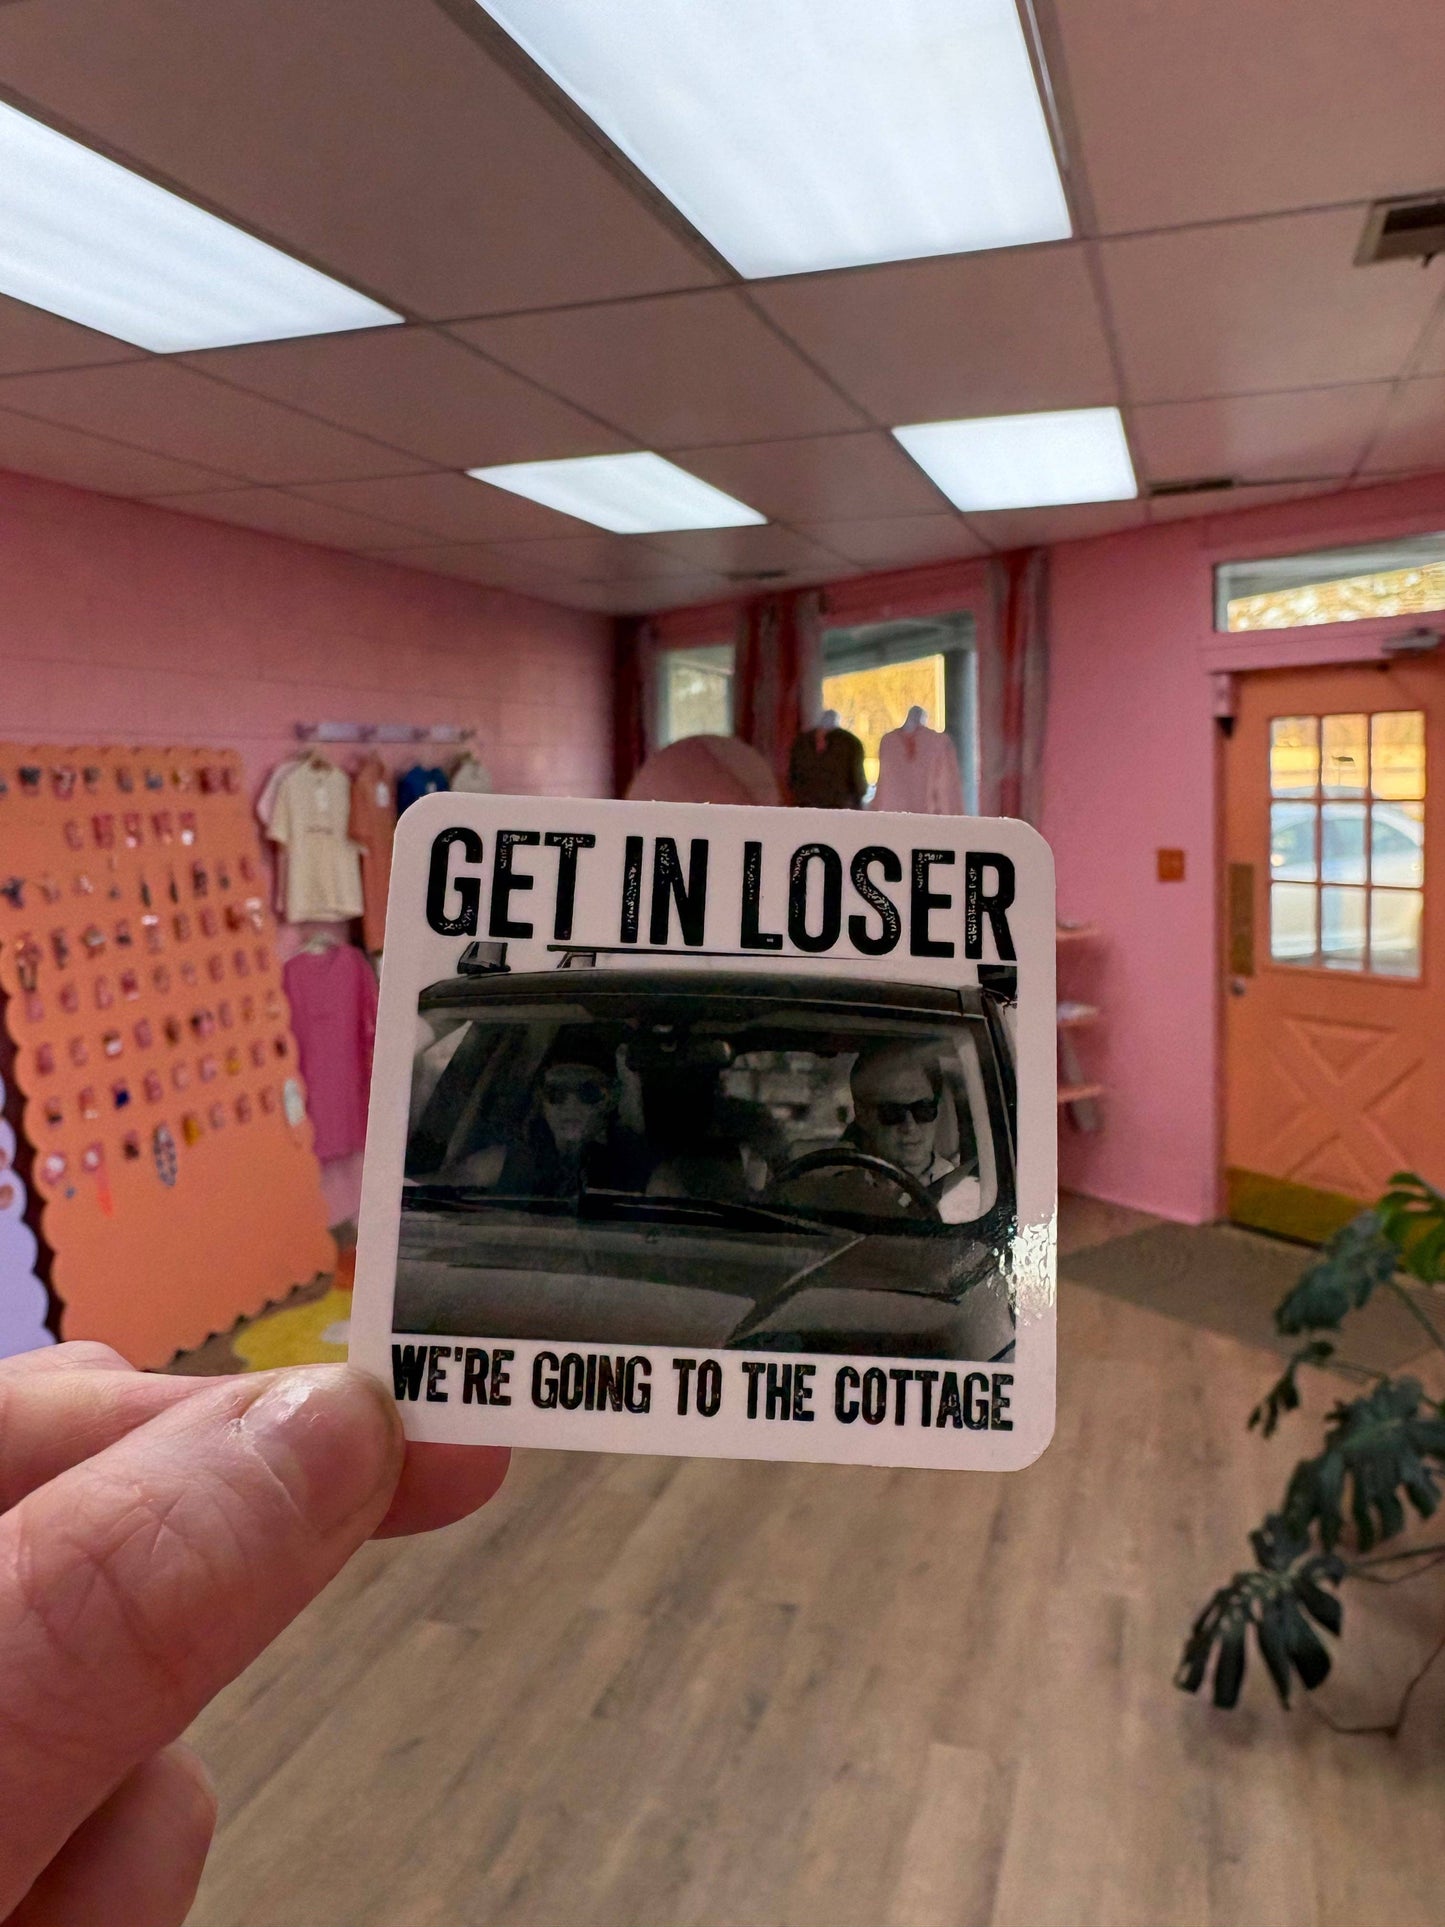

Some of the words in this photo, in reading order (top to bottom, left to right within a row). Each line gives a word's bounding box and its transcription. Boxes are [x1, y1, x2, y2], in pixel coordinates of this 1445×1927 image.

[426, 827, 596, 941] GET
[620, 836, 708, 946] IN
[740, 841, 1017, 961] LOSER
[391, 1344, 515, 1407] WE'RE
[531, 1351, 652, 1414] GOING
[673, 1358, 723, 1418] TO
[741, 1362, 817, 1422] THE
[834, 1366, 1014, 1432] COTTAGE
